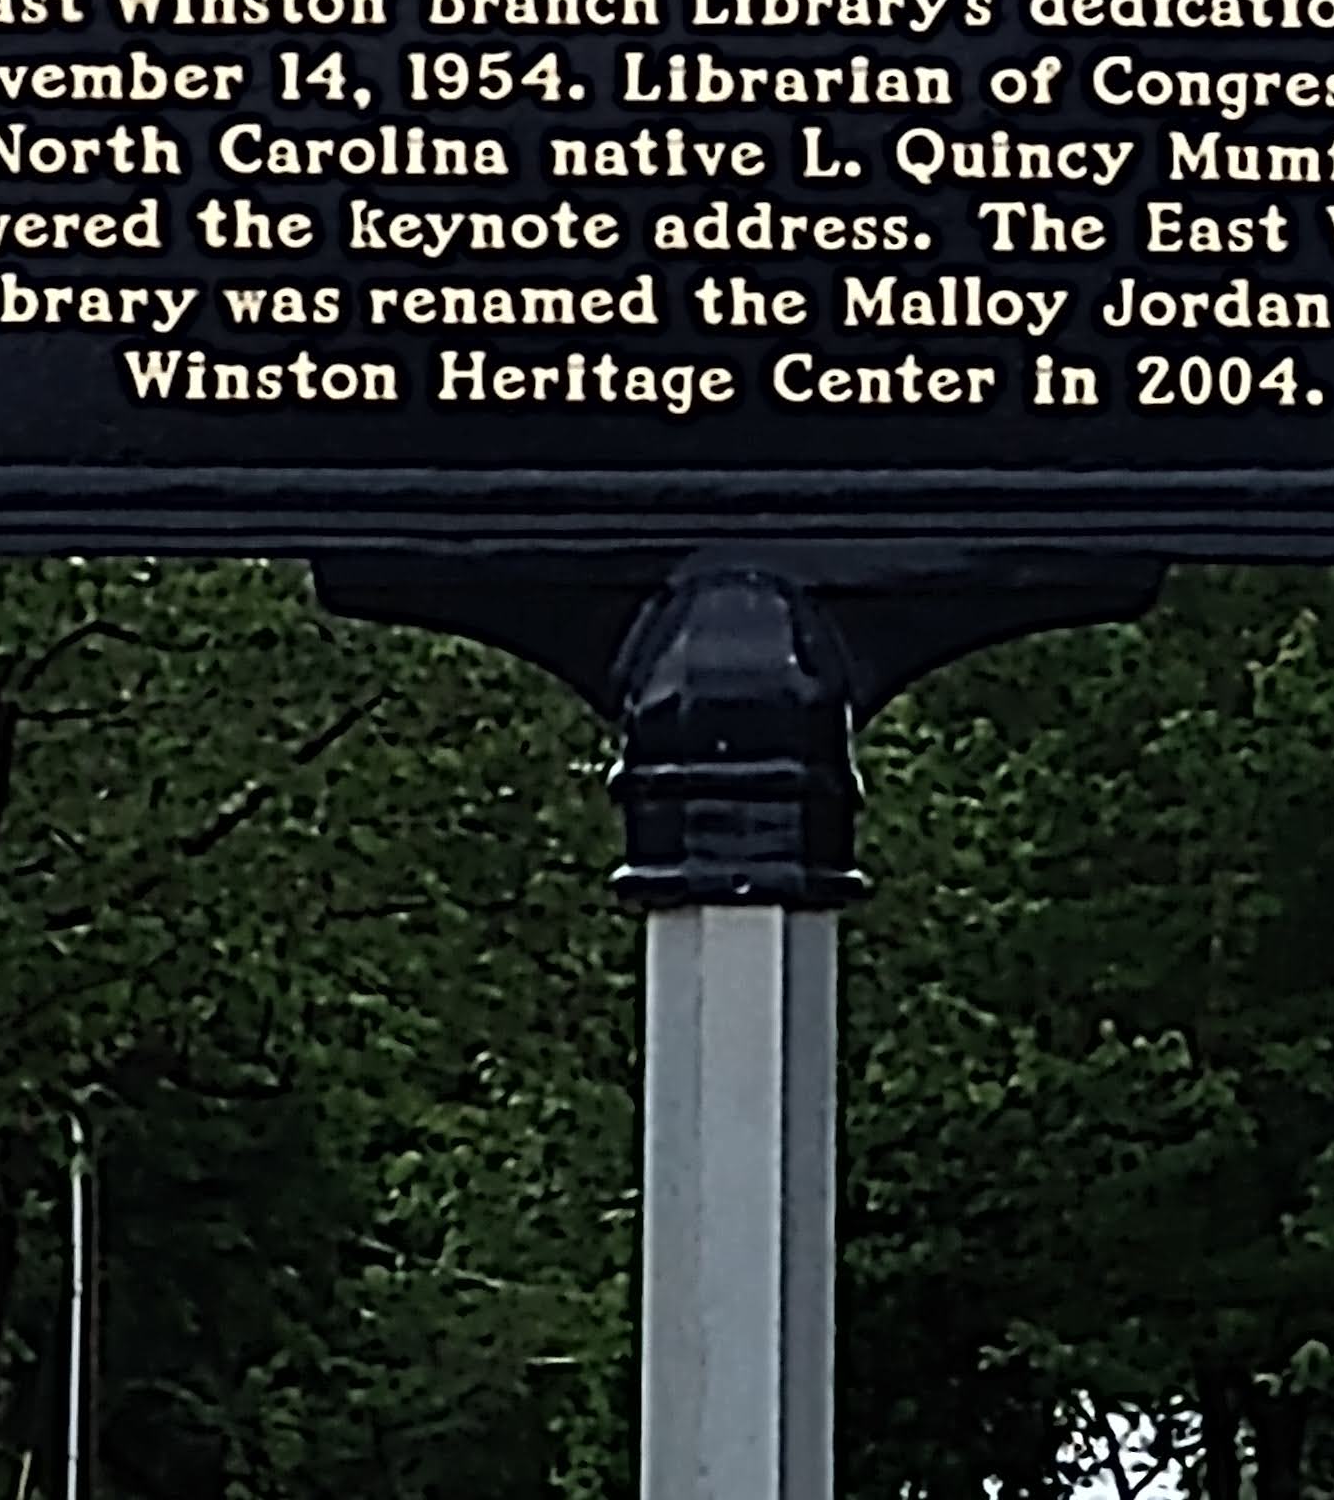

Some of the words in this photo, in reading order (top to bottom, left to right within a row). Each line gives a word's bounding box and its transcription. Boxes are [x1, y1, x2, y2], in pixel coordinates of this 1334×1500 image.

[279, 50, 372, 111] 14,
[407, 50, 586, 102] 1954.
[622, 51, 953, 105] Librarian
[989, 54, 1063, 105] of
[218, 122, 510, 176] Carolina
[549, 127, 766, 178] native
[801, 125, 863, 179] L.
[895, 126, 1135, 187] Quincy
[195, 197, 314, 250] the
[349, 198, 621, 259] keynote
[653, 200, 932, 252] address.
[977, 200, 1107, 253] The
[1146, 201, 1289, 254] East
[222, 286, 341, 325] was
[368, 273, 660, 325] renamed
[693, 275, 808, 327] the
[843, 274, 1069, 337] Malloy
[1101, 276, 1332, 329] Jordan
[123, 349, 399, 401] Winston
[437, 349, 736, 415] Heritage
[772, 352, 996, 405] Center
[1032, 353, 1100, 406] in
[1135, 354, 1325, 407] 2004.
